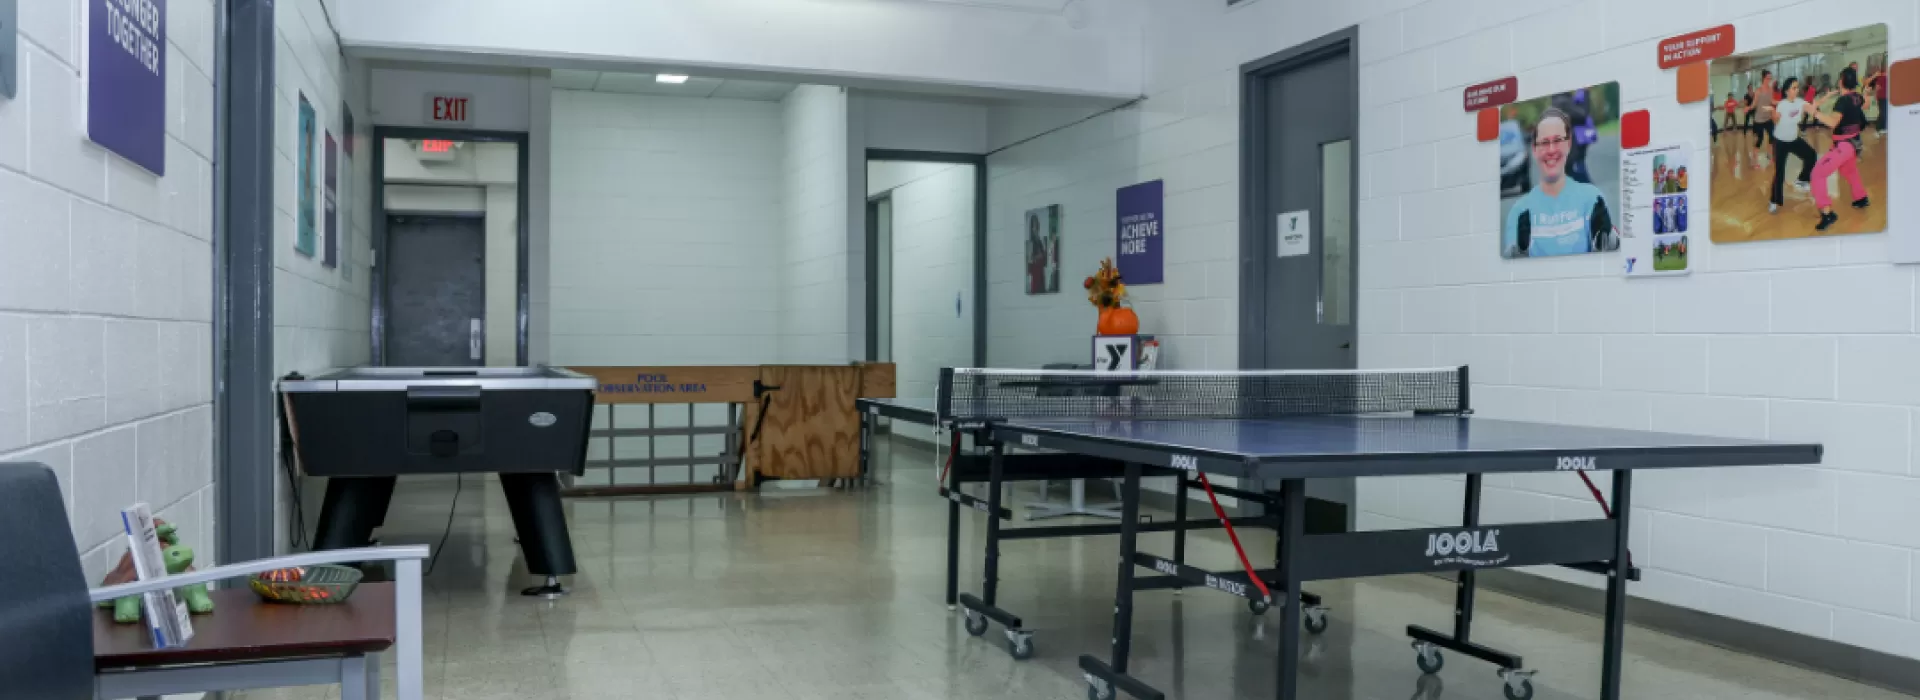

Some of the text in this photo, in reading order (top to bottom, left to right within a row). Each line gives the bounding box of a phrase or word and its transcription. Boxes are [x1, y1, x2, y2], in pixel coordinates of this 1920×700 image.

[105, 0, 159, 77] TOGETHER
[1663, 33, 1721, 51] YOUR SUPPORT
[1673, 48, 1701, 60] ACTION
[433, 96, 468, 121] EXIT
[1121, 220, 1158, 239] ACHIEVE
[1121, 238, 1147, 254] MORE
[637, 373, 668, 383] POOL
[678, 383, 707, 393] AREA
[1556, 456, 1596, 470] JOOLA
[1425, 529, 1499, 556] JOOLA
